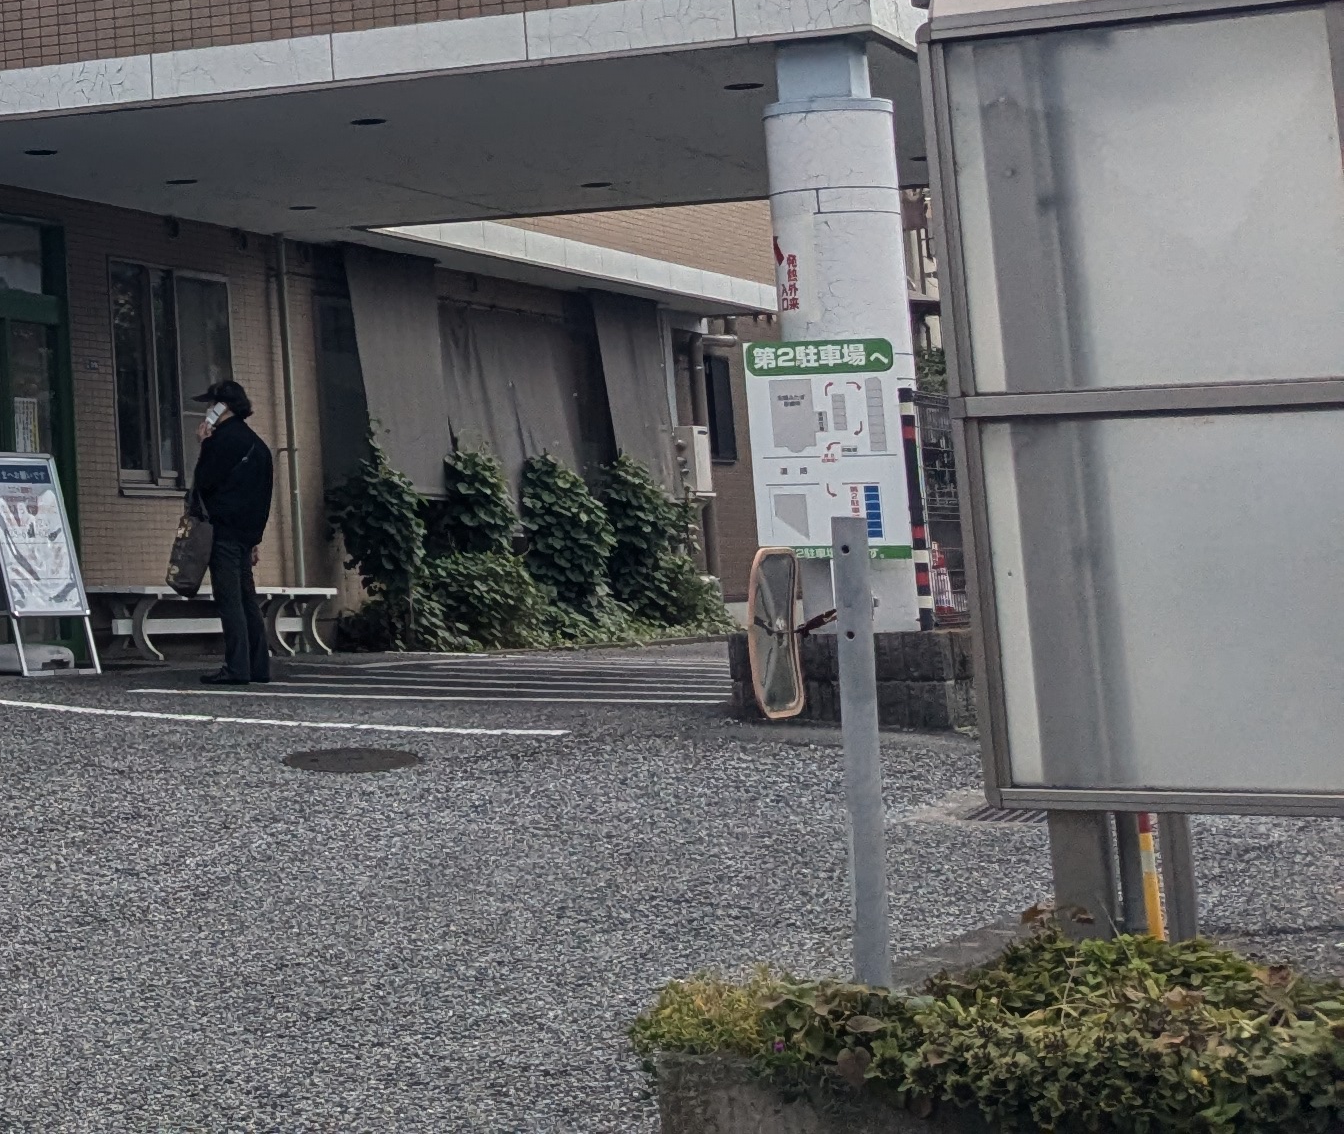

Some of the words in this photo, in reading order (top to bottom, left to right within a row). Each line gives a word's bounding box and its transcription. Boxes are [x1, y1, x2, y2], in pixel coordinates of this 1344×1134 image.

[752, 343, 889, 370] 第2駐車場へ
[849, 485, 861, 517] 第2駐車
